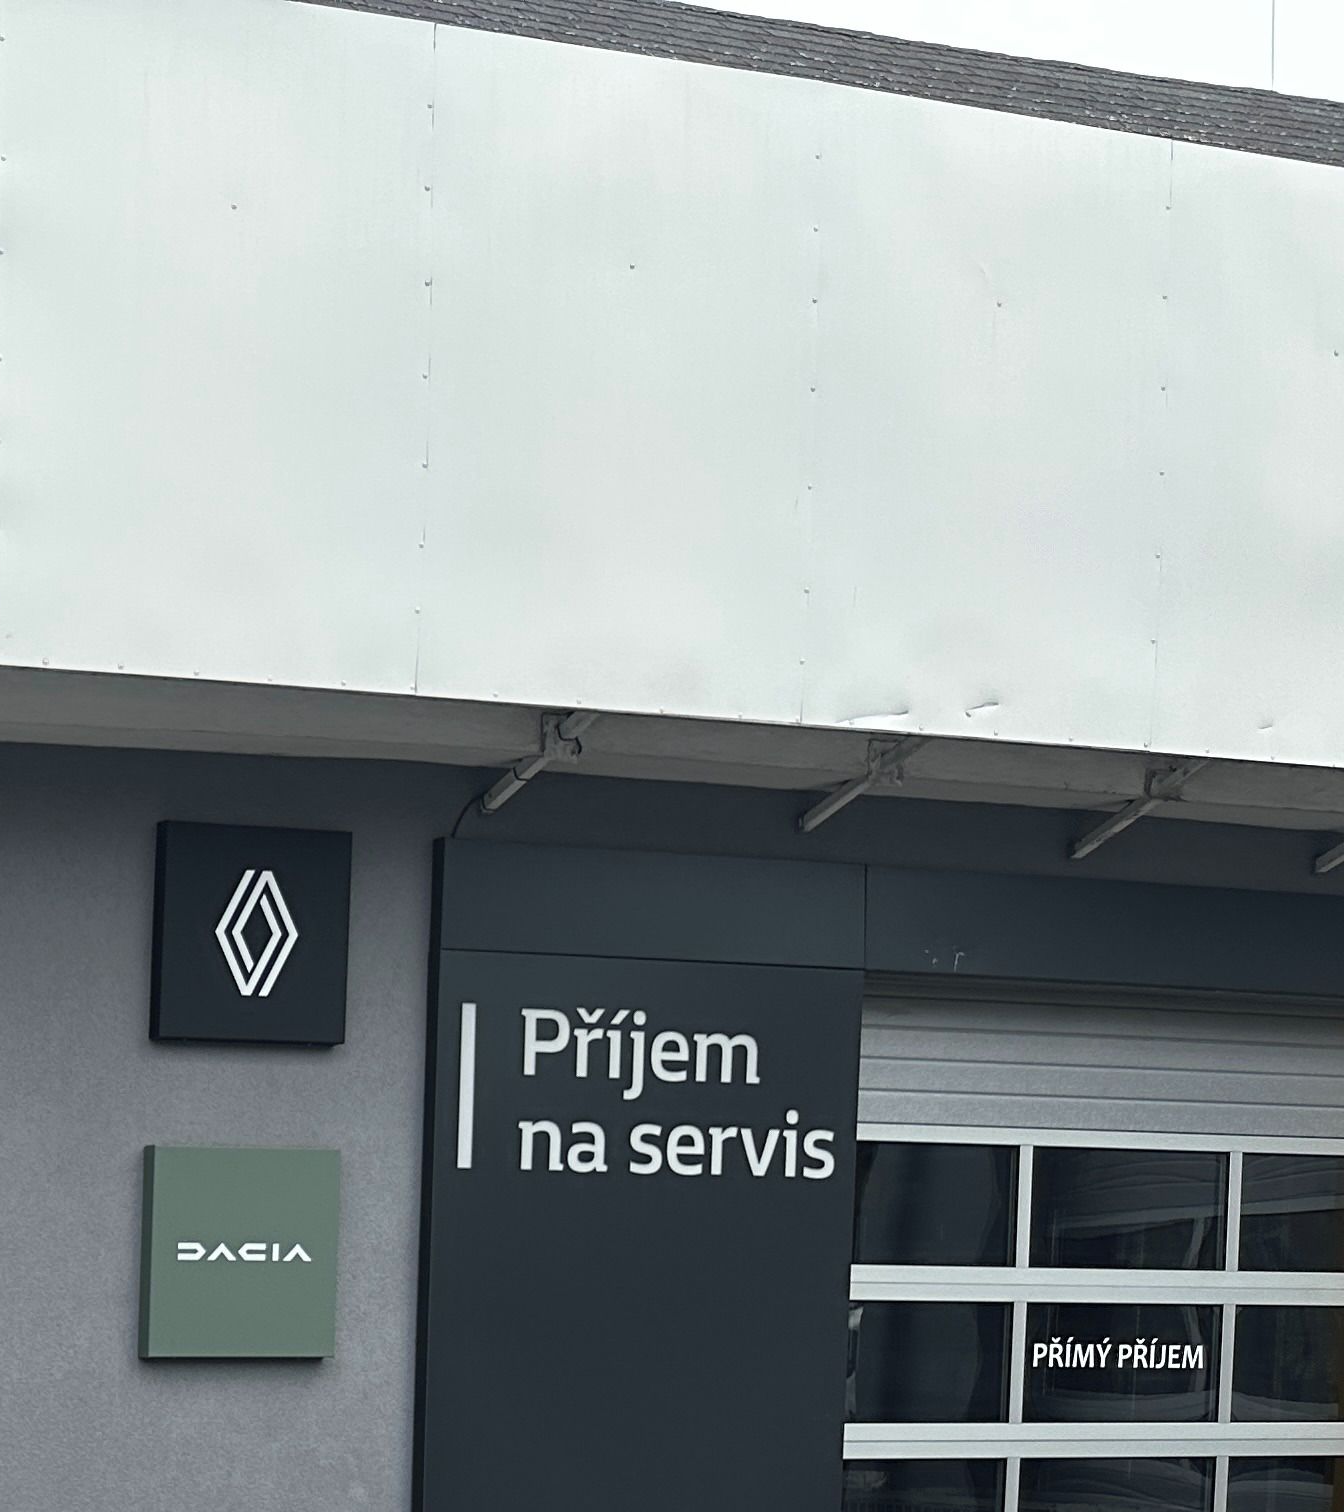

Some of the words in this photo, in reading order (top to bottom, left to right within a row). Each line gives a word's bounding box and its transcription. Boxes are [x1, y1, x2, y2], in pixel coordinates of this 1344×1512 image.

[520, 1007, 760, 1100] Příjem
[518, 1119, 608, 1173] na
[629, 1109, 835, 1179] servis
[177, 1242, 312, 1262] DACIA
[1032, 1336, 1112, 1368] PŘÍMÝ
[1117, 1337, 1204, 1369] PŘÍJEM
